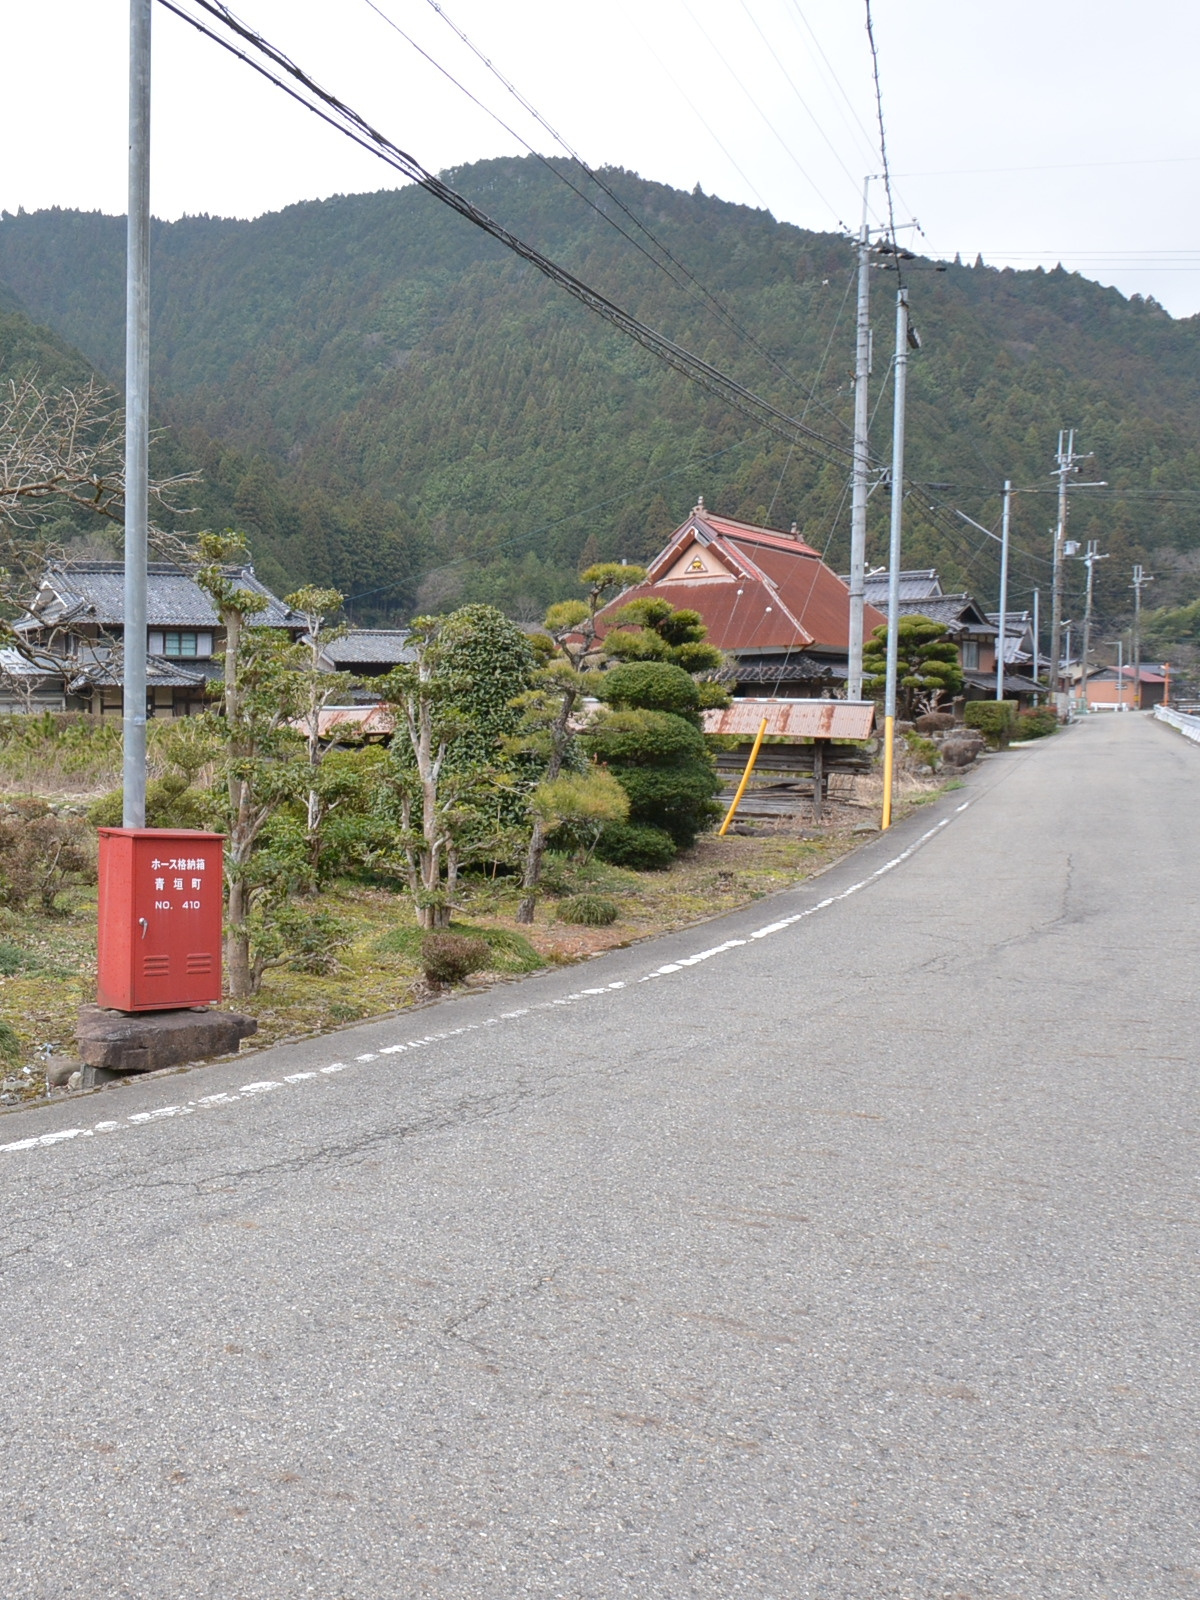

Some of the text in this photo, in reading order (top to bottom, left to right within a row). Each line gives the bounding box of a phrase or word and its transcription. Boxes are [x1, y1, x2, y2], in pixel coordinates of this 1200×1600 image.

[151, 858, 205, 870] ホース格納箱
[155, 877, 201, 891] 青垣町
[155, 901, 200, 910] NO. 410
